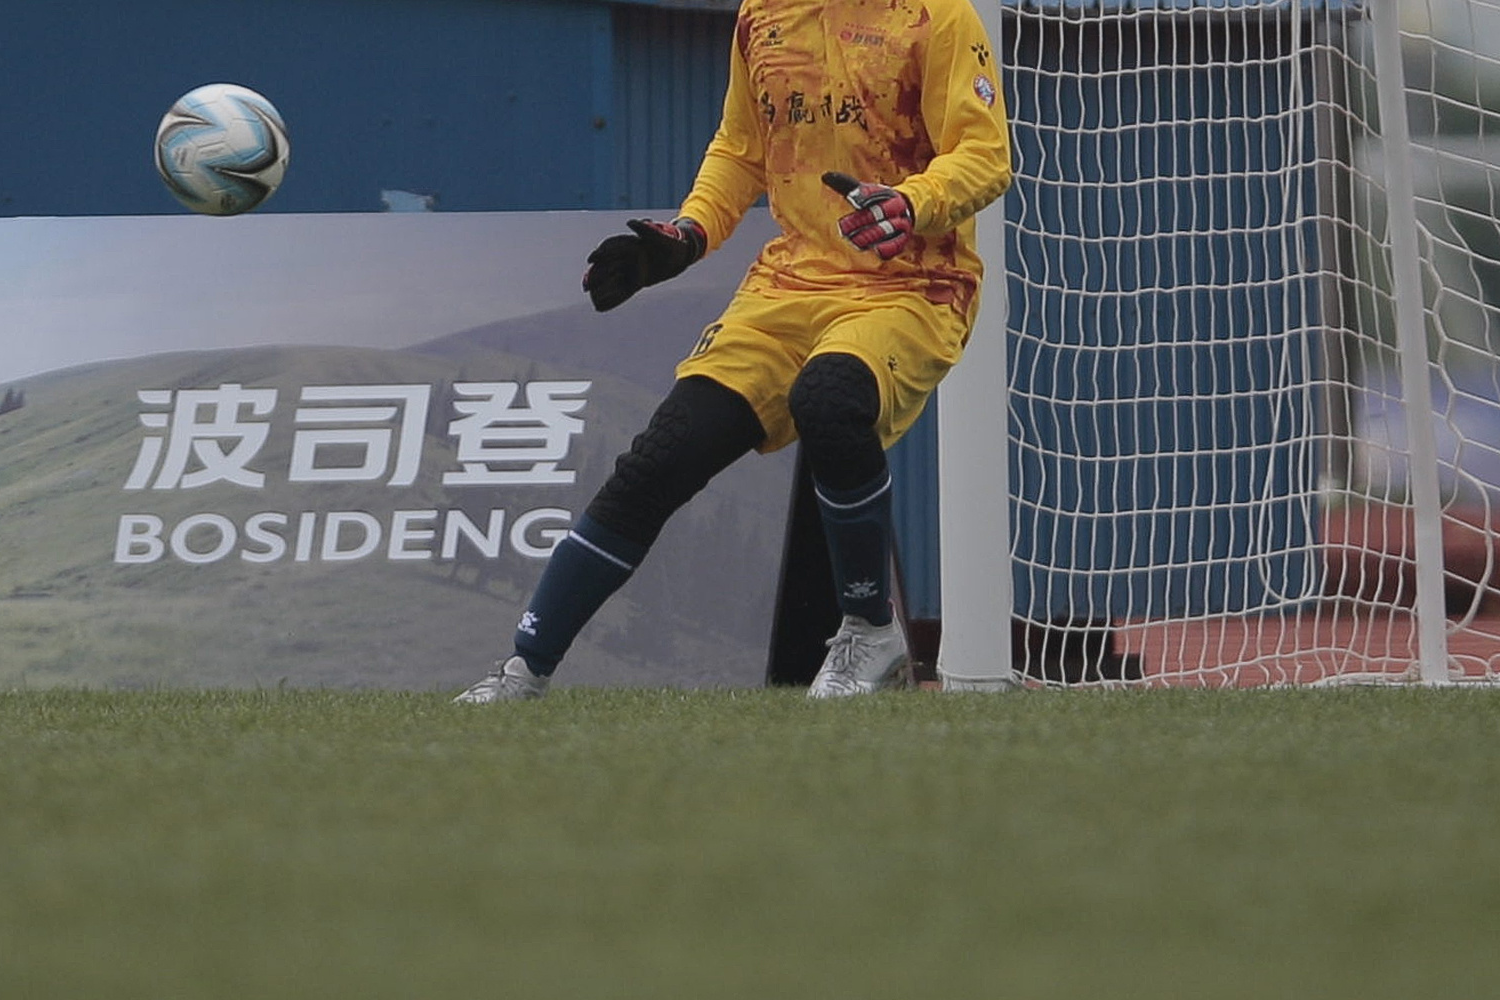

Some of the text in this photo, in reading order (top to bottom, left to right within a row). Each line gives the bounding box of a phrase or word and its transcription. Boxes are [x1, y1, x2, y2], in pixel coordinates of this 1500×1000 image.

[122, 380, 593, 491] 波司登
[113, 507, 574, 564] BOSIDENG
